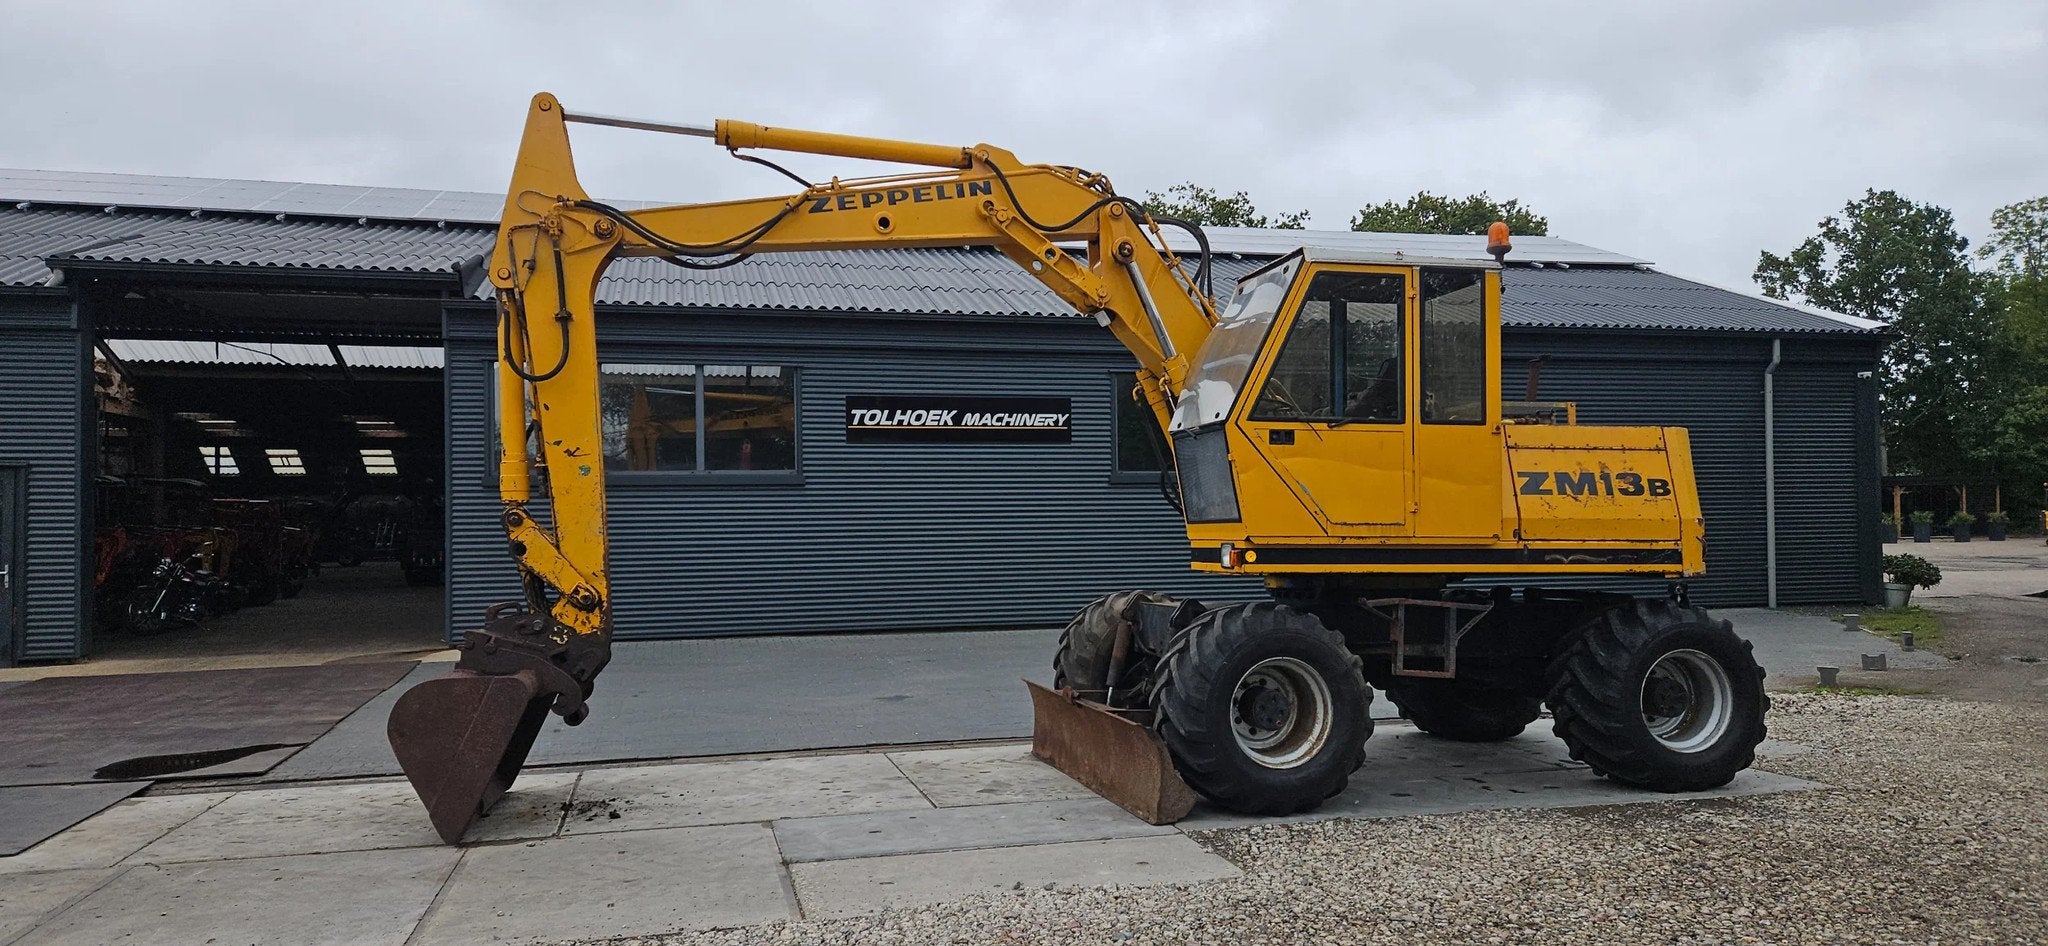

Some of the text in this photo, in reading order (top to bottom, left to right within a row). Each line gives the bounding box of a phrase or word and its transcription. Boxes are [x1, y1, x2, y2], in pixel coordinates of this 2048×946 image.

[808, 180, 992, 213] ZEPPELIN
[851, 409, 1069, 426] TOLHOEK MACHINERY
[1517, 471, 1672, 496] ZM13B
